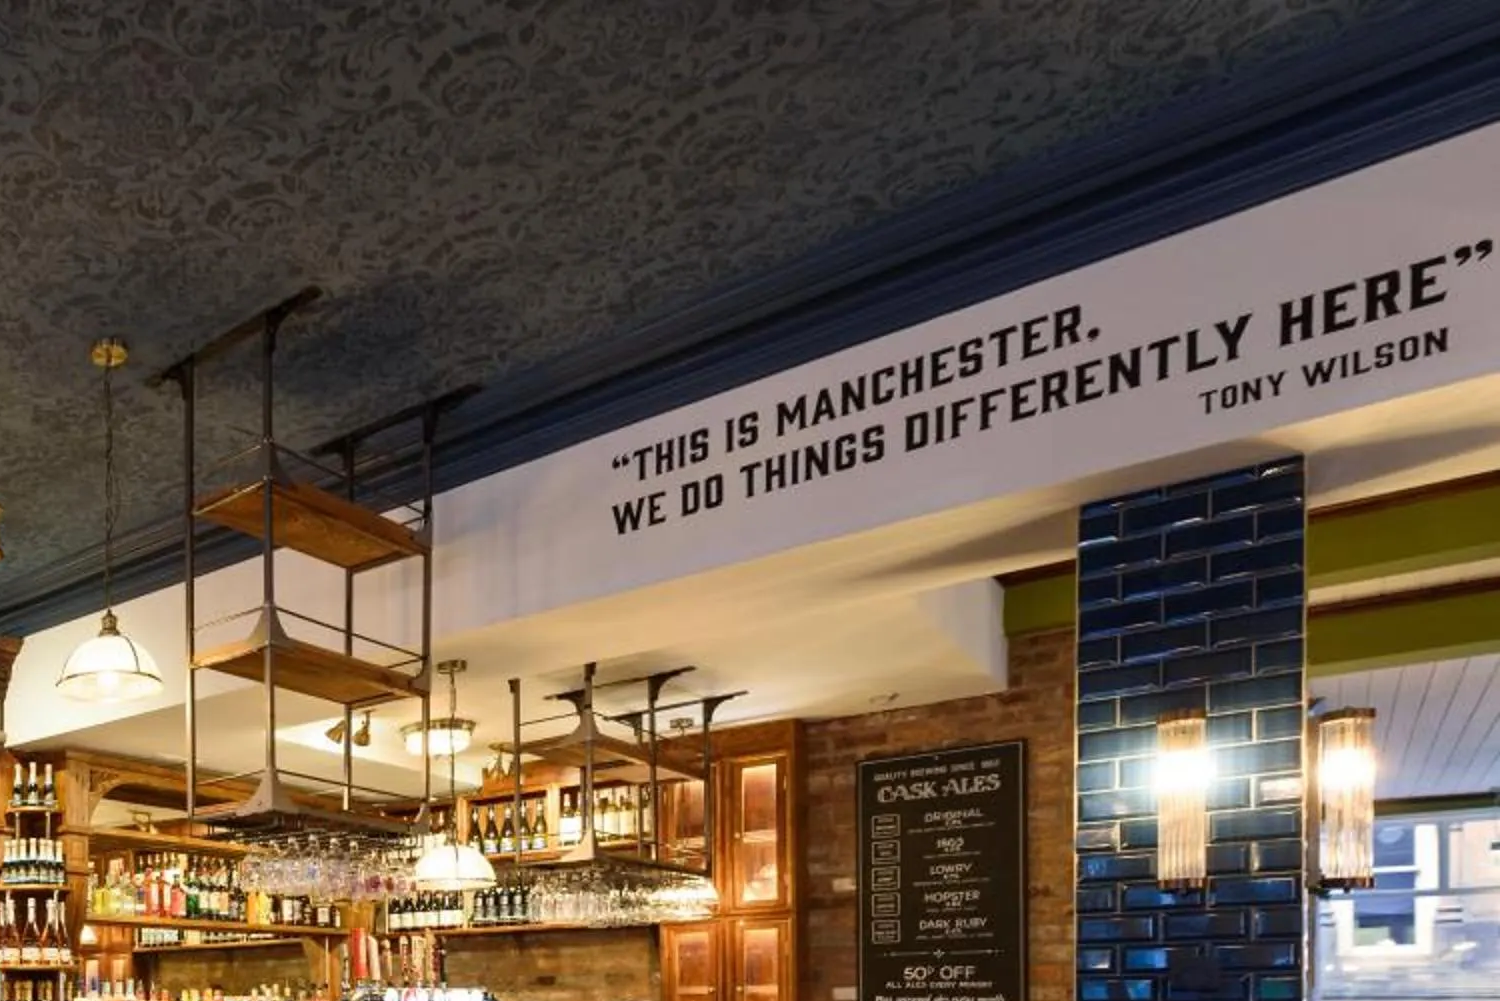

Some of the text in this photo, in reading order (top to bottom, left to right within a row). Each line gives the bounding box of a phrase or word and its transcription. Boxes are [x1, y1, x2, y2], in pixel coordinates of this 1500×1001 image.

[1199, 327, 1450, 415] TONY WILSON
[611, 239, 1493, 535] WE DO THINGS DIFFERENTLY HERE”
[611, 304, 1100, 481] “THIS IS MANCHESTER.
[877, 773, 1001, 803] CASK ALES
[929, 862, 974, 876] LOWRY
[924, 889, 981, 903] HOPSTER
[919, 918, 950, 931] DARK
[955, 916, 988, 929] RUBY
[939, 964, 977, 981] OFF
